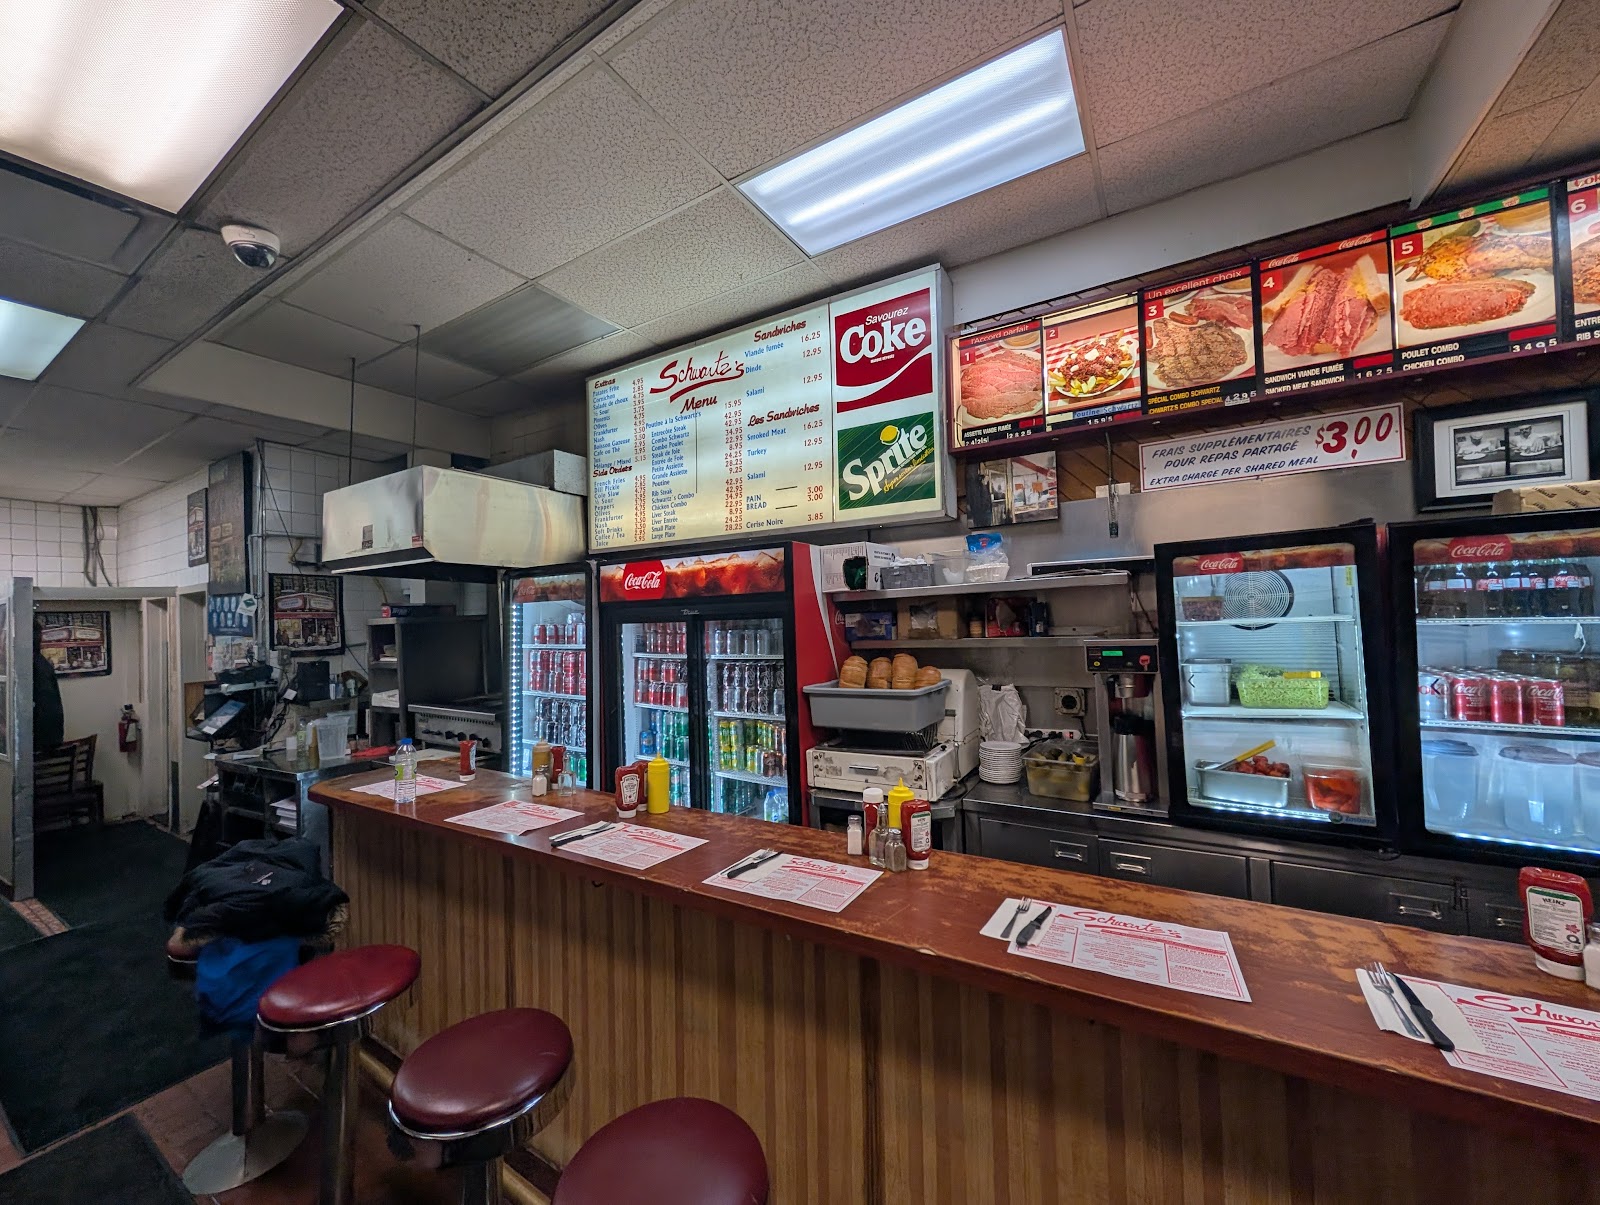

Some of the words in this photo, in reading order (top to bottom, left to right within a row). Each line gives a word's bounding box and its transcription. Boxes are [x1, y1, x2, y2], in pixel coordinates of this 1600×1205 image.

[1571, 199, 1587, 213] 6
[1268, 254, 1299, 268] Coca-Cola
[1338, 235, 1372, 250] Coca-Cola
[1401, 240, 1413, 255] 5
[1148, 290, 1162, 300] Un
[1165, 279, 1209, 295] excellent
[1212, 270, 1242, 284] choix
[1263, 277, 1275, 288] 4
[1148, 305, 1157, 316] 3
[865, 307, 908, 326] Savourez
[753, 320, 806, 343] Sandwiches
[800, 331, 821, 343] 16.25
[1049, 329, 1056, 337] 2
[1576, 332, 1591, 341] RIB
[840, 318, 926, 363] Coke
[745, 347, 764, 358] Viande
[802, 347, 822, 358] 12.95
[964, 352, 970, 361] 1
[1402, 347, 1429, 360] POULET
[1431, 342, 1459, 355] COMBO
[1403, 359, 1435, 371] CHICKEN
[1436, 355, 1465, 366] COMBO
[650, 350, 745, 394] Schwartz's
[746, 364, 762, 374] Dinde
[1265, 371, 1296, 384] SANDWICH
[1297, 368, 1320, 378] VIANDE
[1322, 363, 1344, 374] FUMÉE
[594, 379, 616, 389] Extras
[803, 373, 823, 384] 12.95
[1265, 385, 1291, 395] SMOKED
[1293, 382, 1309, 390] MEAT
[1311, 375, 1345, 387] SANDWICH
[746, 386, 765, 397] Salami
[1170, 392, 1189, 400] COMBO
[1191, 386, 1220, 397] SCHWARTZ
[593, 393, 615, 403] Cornichon
[724, 399, 741, 408] 15.95
[593, 402, 607, 410] Salade
[680, 395, 717, 414] Menu
[1149, 404, 1178, 414] CHWARTZ'S
[1180, 401, 1199, 409] COMBO
[1201, 397, 1223, 406] SPECIAL
[724, 410, 741, 419] 42.95
[748, 415, 764, 426] Les
[766, 404, 820, 422] Sandwiches
[593, 423, 607, 431] Olives
[646, 420, 663, 429] Poutine
[674, 424, 686, 432] Steak
[725, 418, 742, 427] 42.95
[803, 420, 823, 430] 16.25
[593, 427, 618, 437] Frankfurter
[725, 426, 742, 436] 34.95
[747, 431, 769, 441] Smoked
[772, 428, 786, 436] Meat
[652, 436, 667, 444] Combo
[669, 431, 689, 440] Schwartz
[726, 435, 742, 444] 22.95
[804, 437, 822, 447] 12.95
[1152, 446, 1185, 459] FRAIS
[1189, 425, 1312, 454] SUPPLÉMENTAIRES
[652, 443, 667, 452] Combo
[669, 440, 683, 448] Poulet
[747, 448, 767, 457] Turkey
[1164, 456, 1196, 470] POUR
[1199, 450, 1238, 464] REPAS
[1242, 439, 1300, 456] PARTAGÉ
[804, 461, 822, 471] 12.95
[843, 425, 927, 500] Sprite
[593, 469, 608, 477] Side
[609, 465, 632, 474] Orders
[729, 466, 742, 474] 9.25
[747, 471, 766, 480] Salami
[1150, 475, 1180, 486] EXTRA
[1182, 469, 1218, 481] CHARGE
[1221, 466, 1240, 476] PER
[1246, 460, 1285, 473] SHARED
[1288, 456, 1319, 468] MEAL
[652, 472, 668, 480] Grande
[725, 477, 742, 485] 42.95
[807, 485, 823, 494] 3.00
[677, 492, 694, 500] Combo
[725, 492, 742, 500] 34.95
[746, 494, 761, 502] PAIN
[807, 493, 823, 501] 3.00
[652, 504, 669, 512] Chicken
[671, 501, 687, 509] Combo
[746, 502, 767, 510] BREAD
[725, 515, 742, 523] 24.25
[807, 513, 823, 521] 3.85
[725, 523, 742, 531] 28.25
[1451, 543, 1505, 557] Coca-Cola
[1201, 557, 1239, 571] Coca-Cola
[624, 570, 662, 590] Coca-Cola
[1058, 911, 1182, 938] Schwartz's
